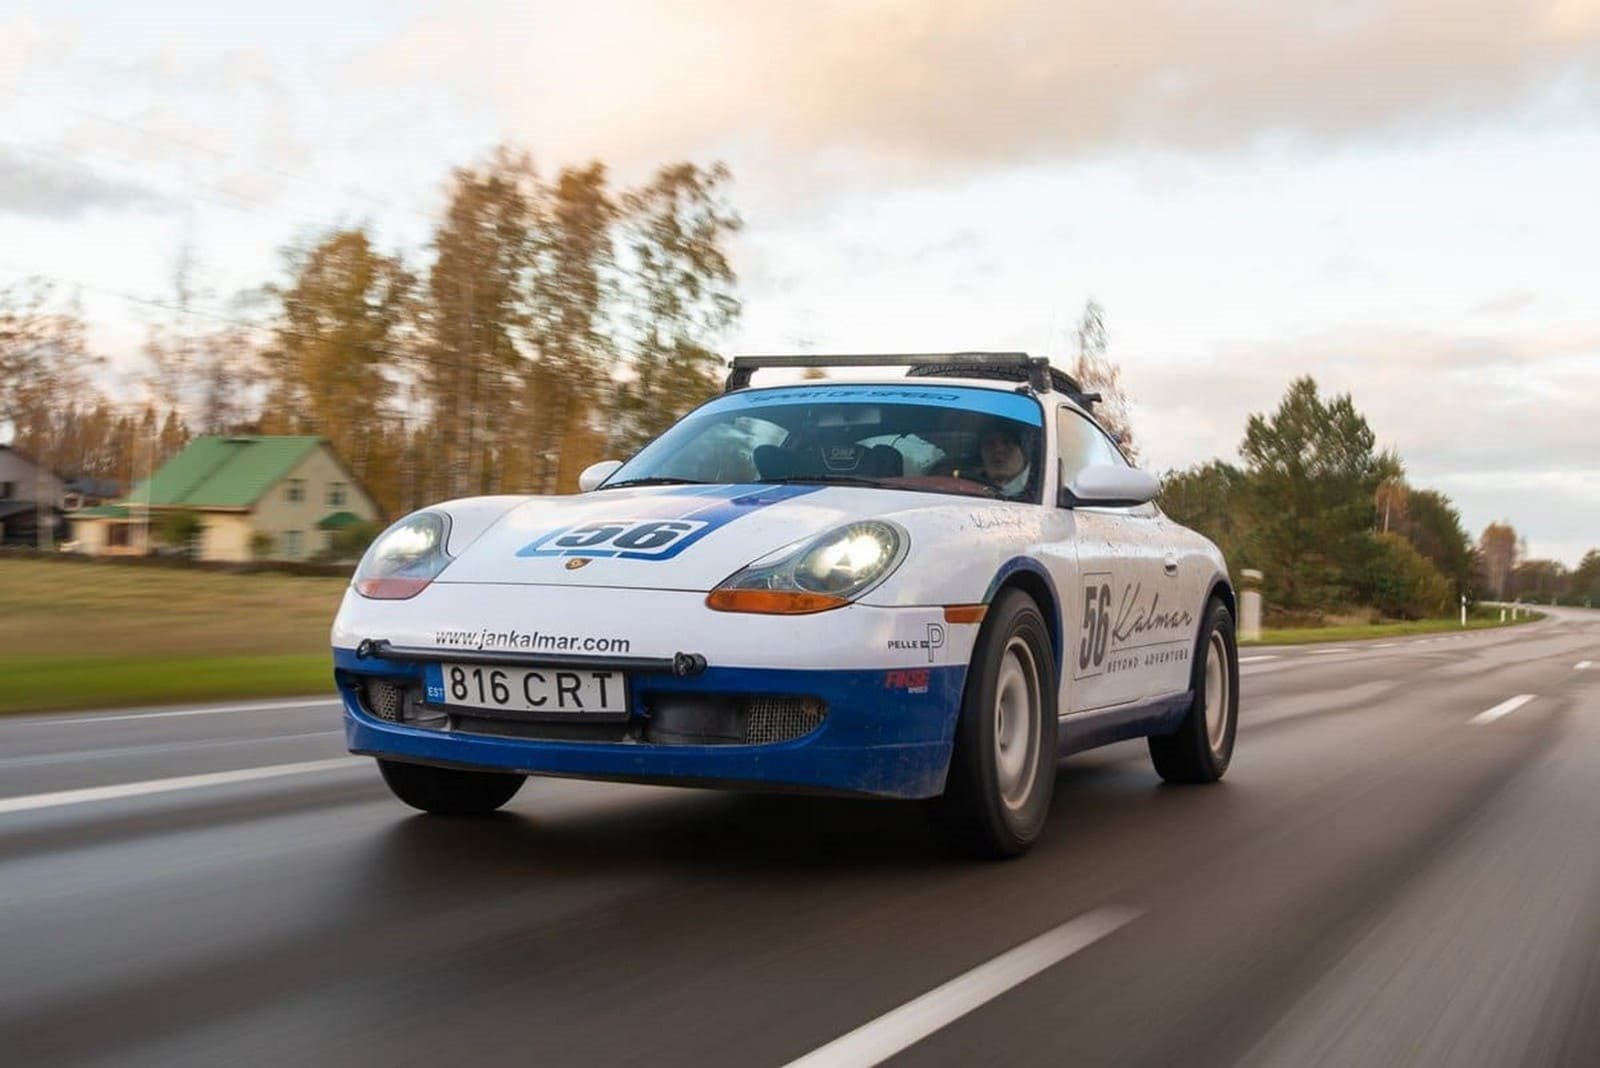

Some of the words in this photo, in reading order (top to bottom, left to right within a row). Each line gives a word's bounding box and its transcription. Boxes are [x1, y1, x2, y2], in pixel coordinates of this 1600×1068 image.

[555, 521, 692, 549] 56
[1078, 583, 1111, 671] 56
[1111, 581, 1193, 646] Kalmar
[435, 629, 631, 653] www.jankalmar.com
[887, 640, 918, 650] PELLE
[427, 686, 443, 698] EST
[450, 666, 510, 705] 816
[523, 672, 613, 709] CRT
